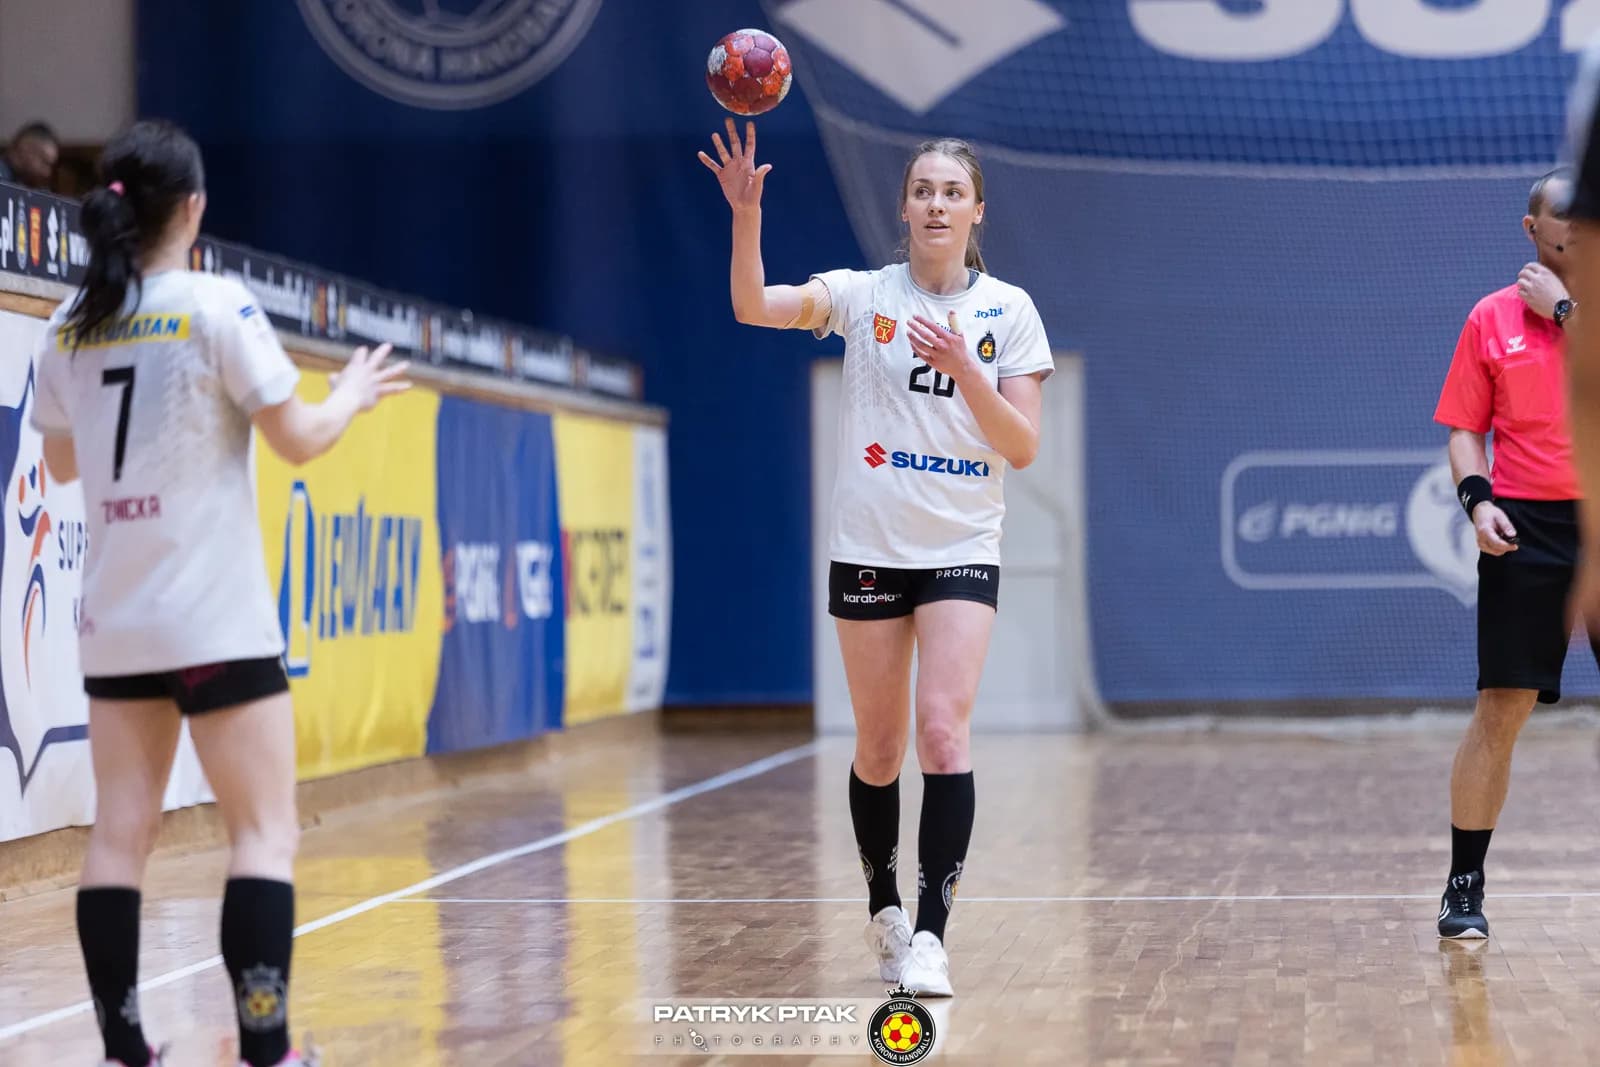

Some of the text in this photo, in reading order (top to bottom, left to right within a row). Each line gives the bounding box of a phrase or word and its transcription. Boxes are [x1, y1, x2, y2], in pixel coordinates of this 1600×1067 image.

[875, 325, 891, 342] CK
[102, 366, 136, 482] 7
[891, 450, 990, 477] SUZUKI
[936, 568, 989, 581] PROFIKA
[843, 592, 895, 604] karabela
